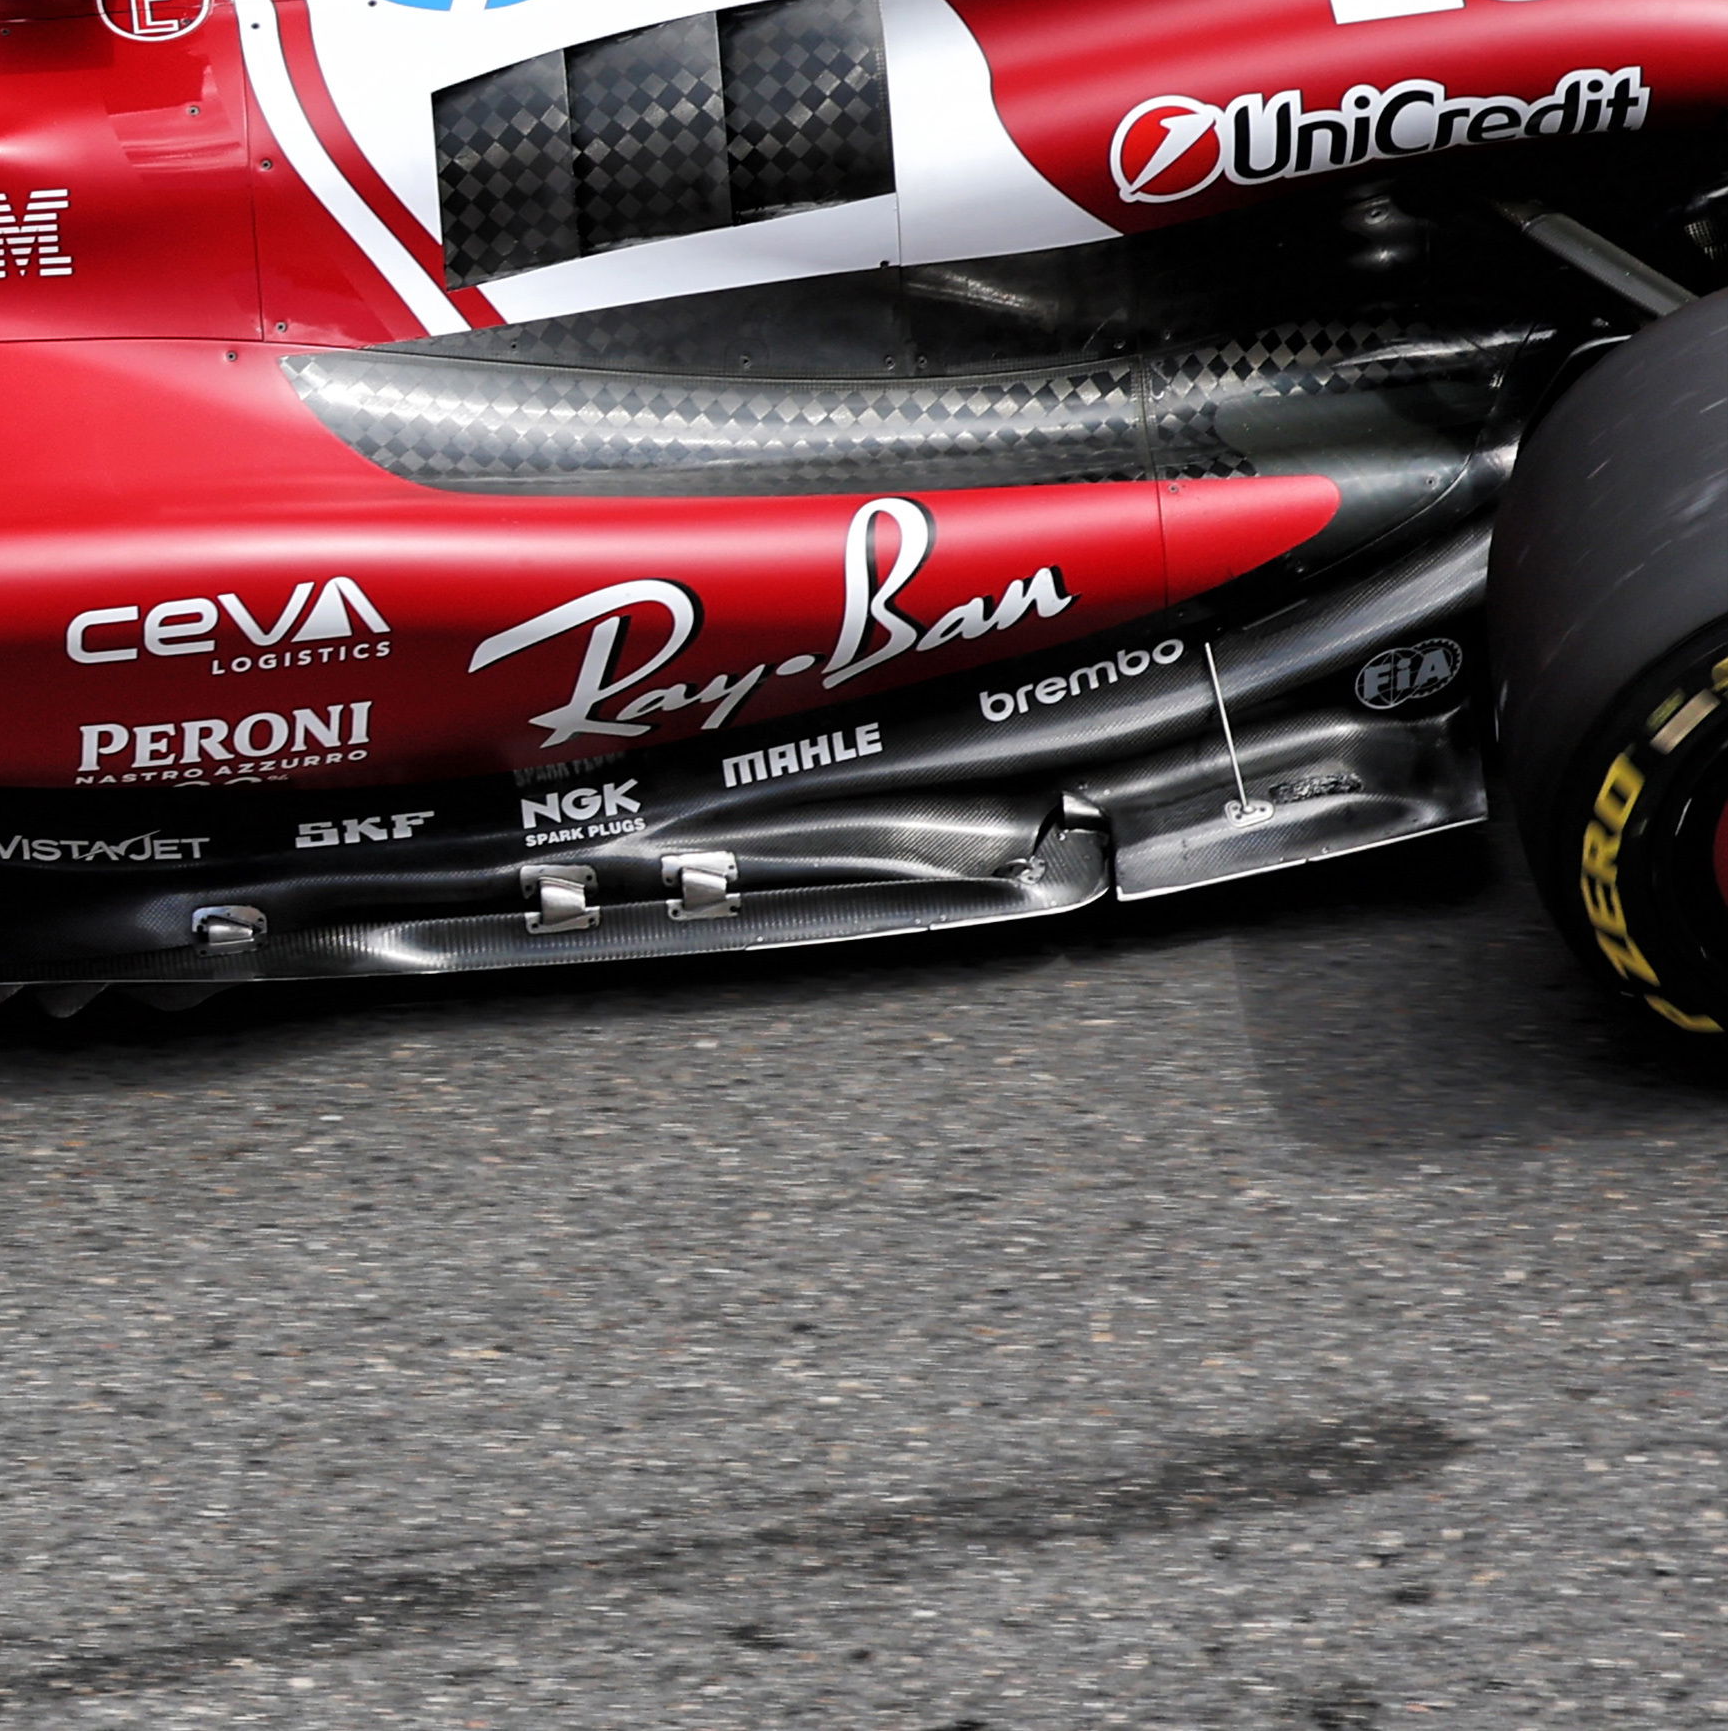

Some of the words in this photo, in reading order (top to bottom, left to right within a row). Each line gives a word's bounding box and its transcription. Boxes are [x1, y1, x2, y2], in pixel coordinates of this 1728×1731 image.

[1228, 67, 1650, 185] UniCredit
[468, 497, 1075, 748] Ray-Ban
[209, 640, 392, 675] LOGISTICS
[979, 637, 1186, 724] brembo
[74, 768, 203, 785] NASTRO
[214, 749, 369, 777] AZZURRO
[77, 700, 373, 772] PERONI
[722, 722, 884, 789] MAHLE
[295, 810, 435, 849] SKF
[519, 778, 641, 830] NGK
[524, 826, 585, 848] SPARK
[588, 817, 647, 837] PLUGS
[1580, 752, 1661, 987] ZERO
